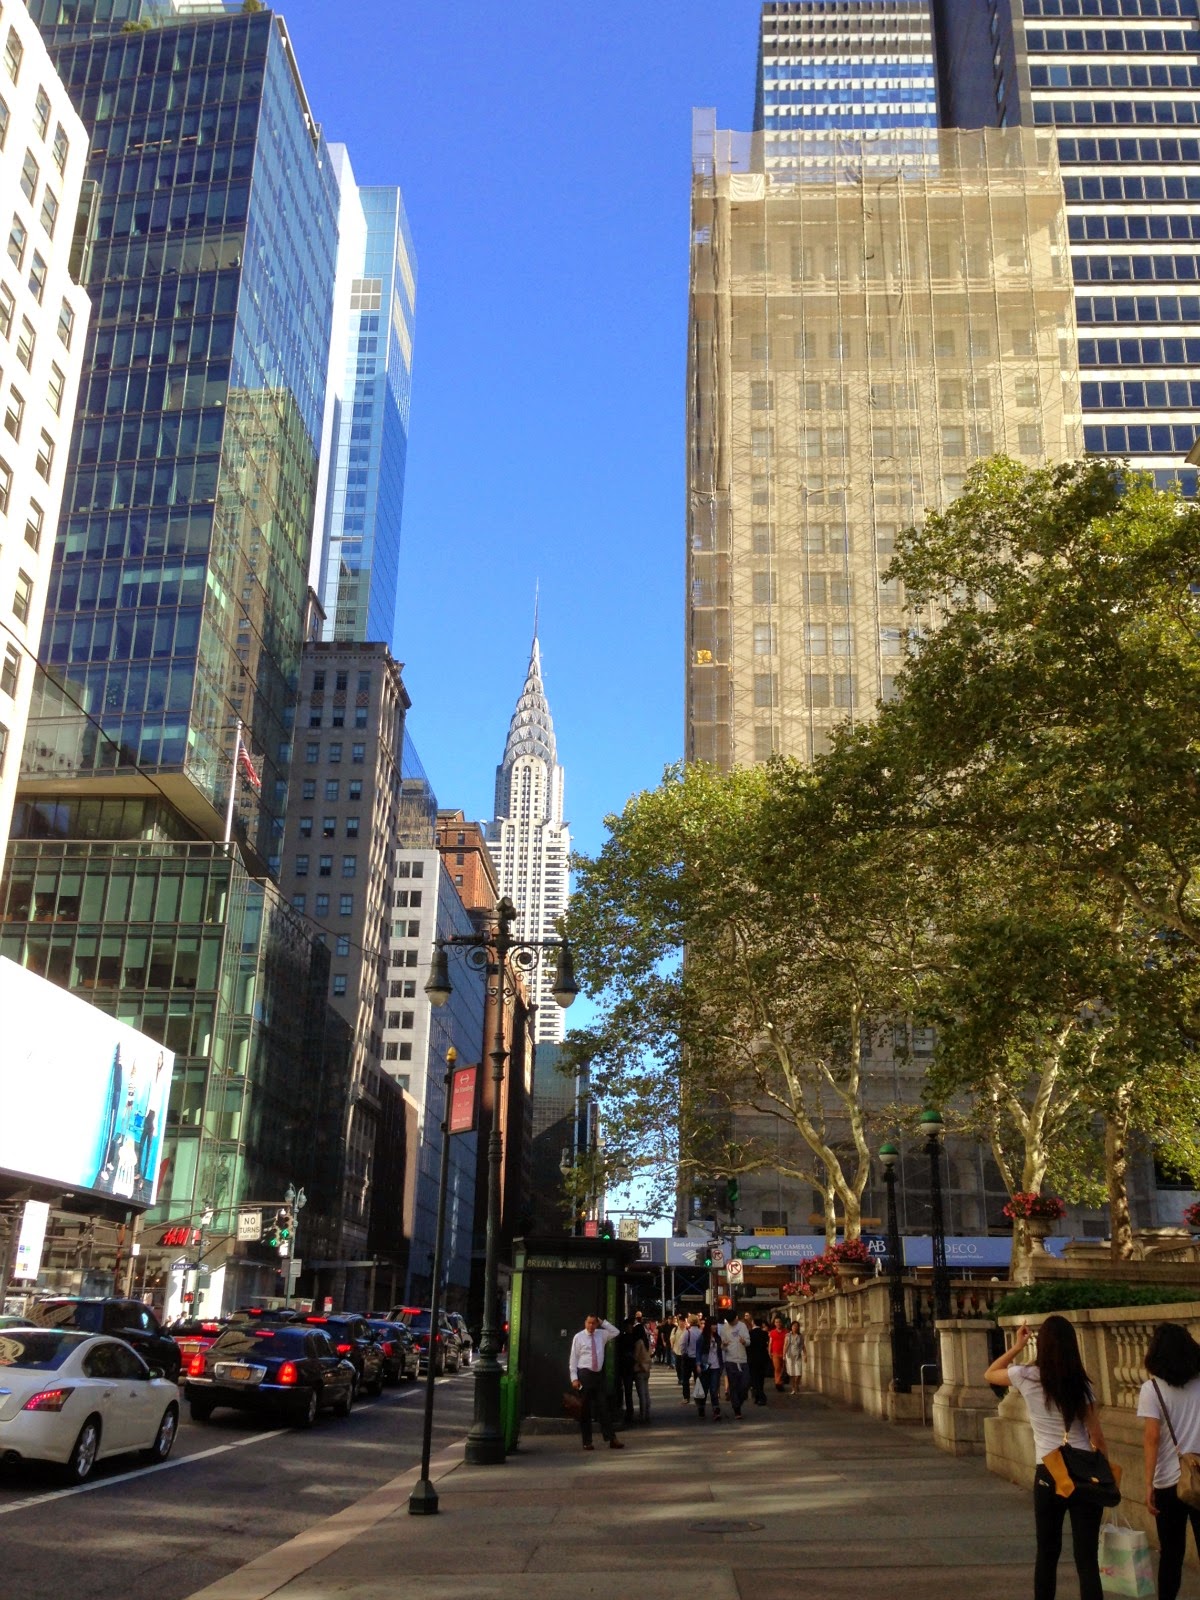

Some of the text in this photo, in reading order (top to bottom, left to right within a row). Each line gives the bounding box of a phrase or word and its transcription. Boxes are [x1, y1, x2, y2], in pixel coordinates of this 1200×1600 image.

[244, 1217, 256, 1225] NO
[239, 1226, 260, 1234] TURNS
[624, 1222, 634, 1230] NO
[163, 1227, 191, 1246] H&M
[620, 1231, 638, 1239] TURNS
[527, 1260, 602, 1270] BRYANT PARK NEWS
